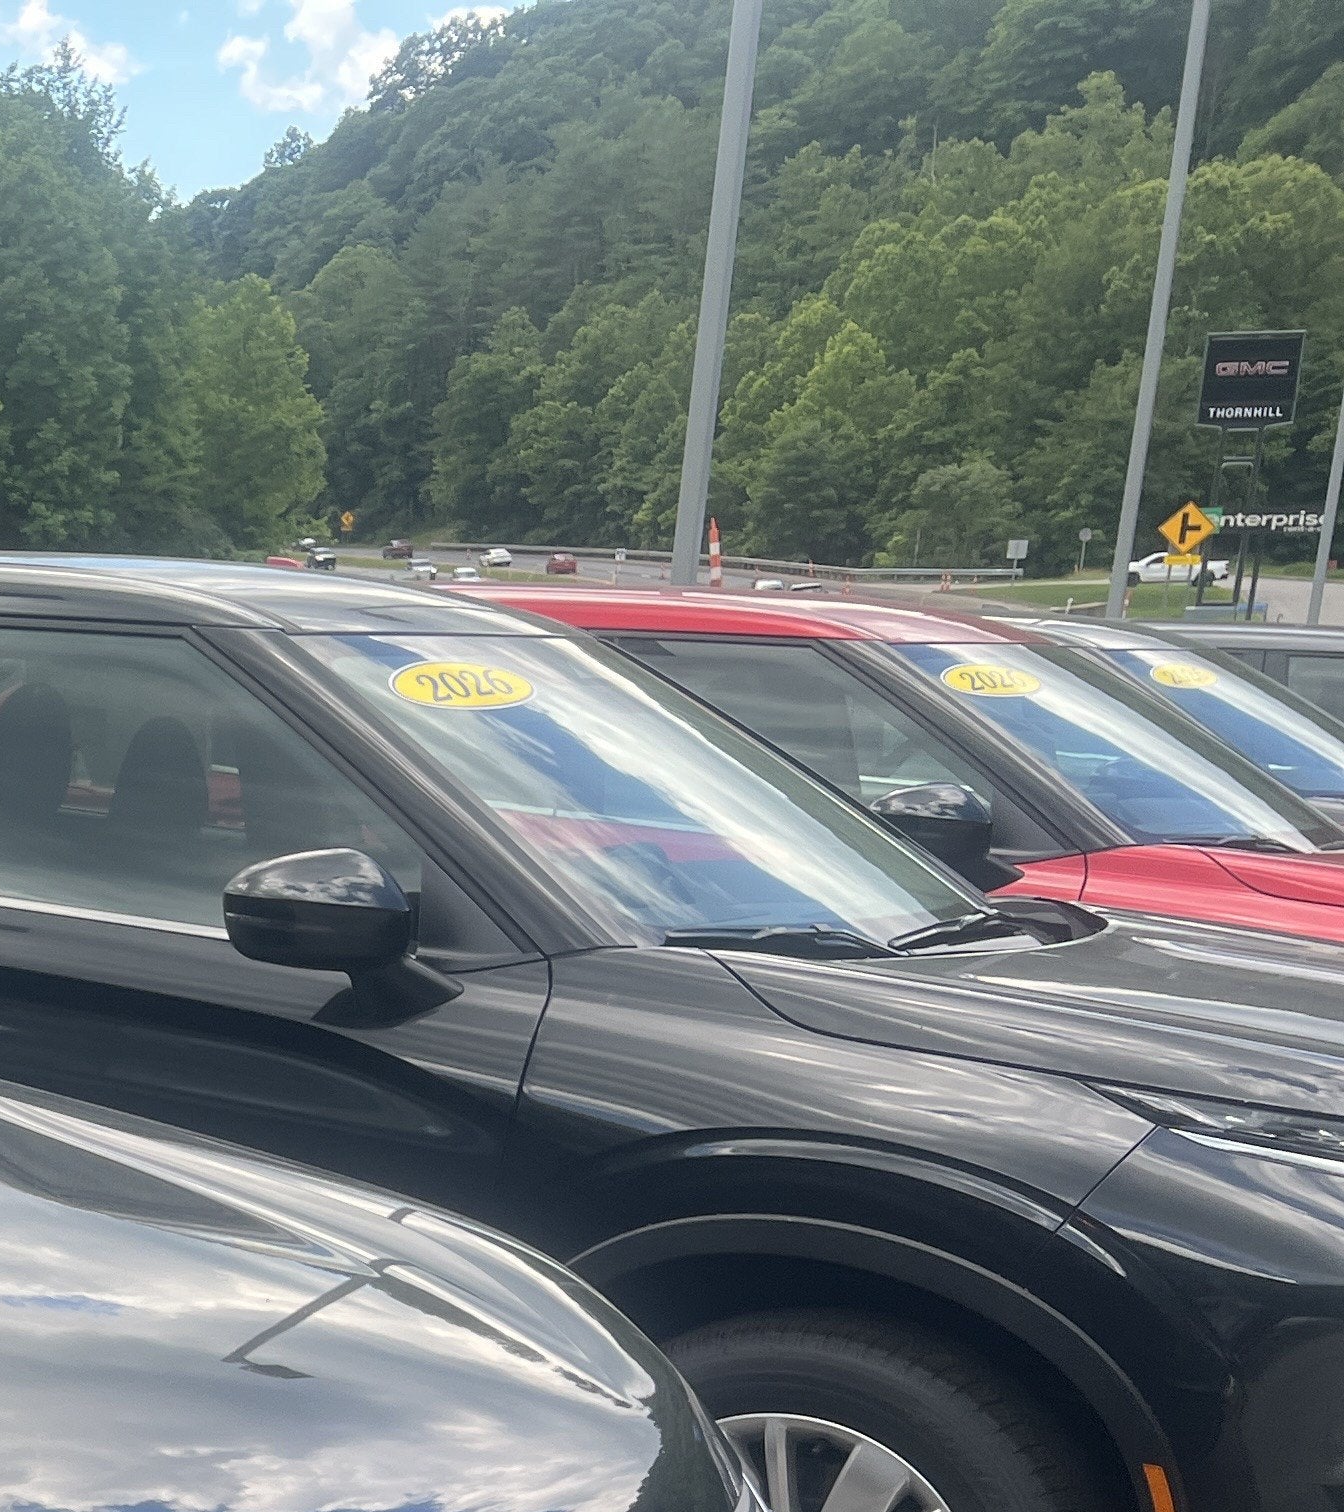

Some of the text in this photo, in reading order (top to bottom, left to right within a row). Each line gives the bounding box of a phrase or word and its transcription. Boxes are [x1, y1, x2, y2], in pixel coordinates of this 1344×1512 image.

[1215, 360, 1290, 377] GMC
[1208, 406, 1284, 419] THORNHILL
[415, 669, 514, 702] 2026
